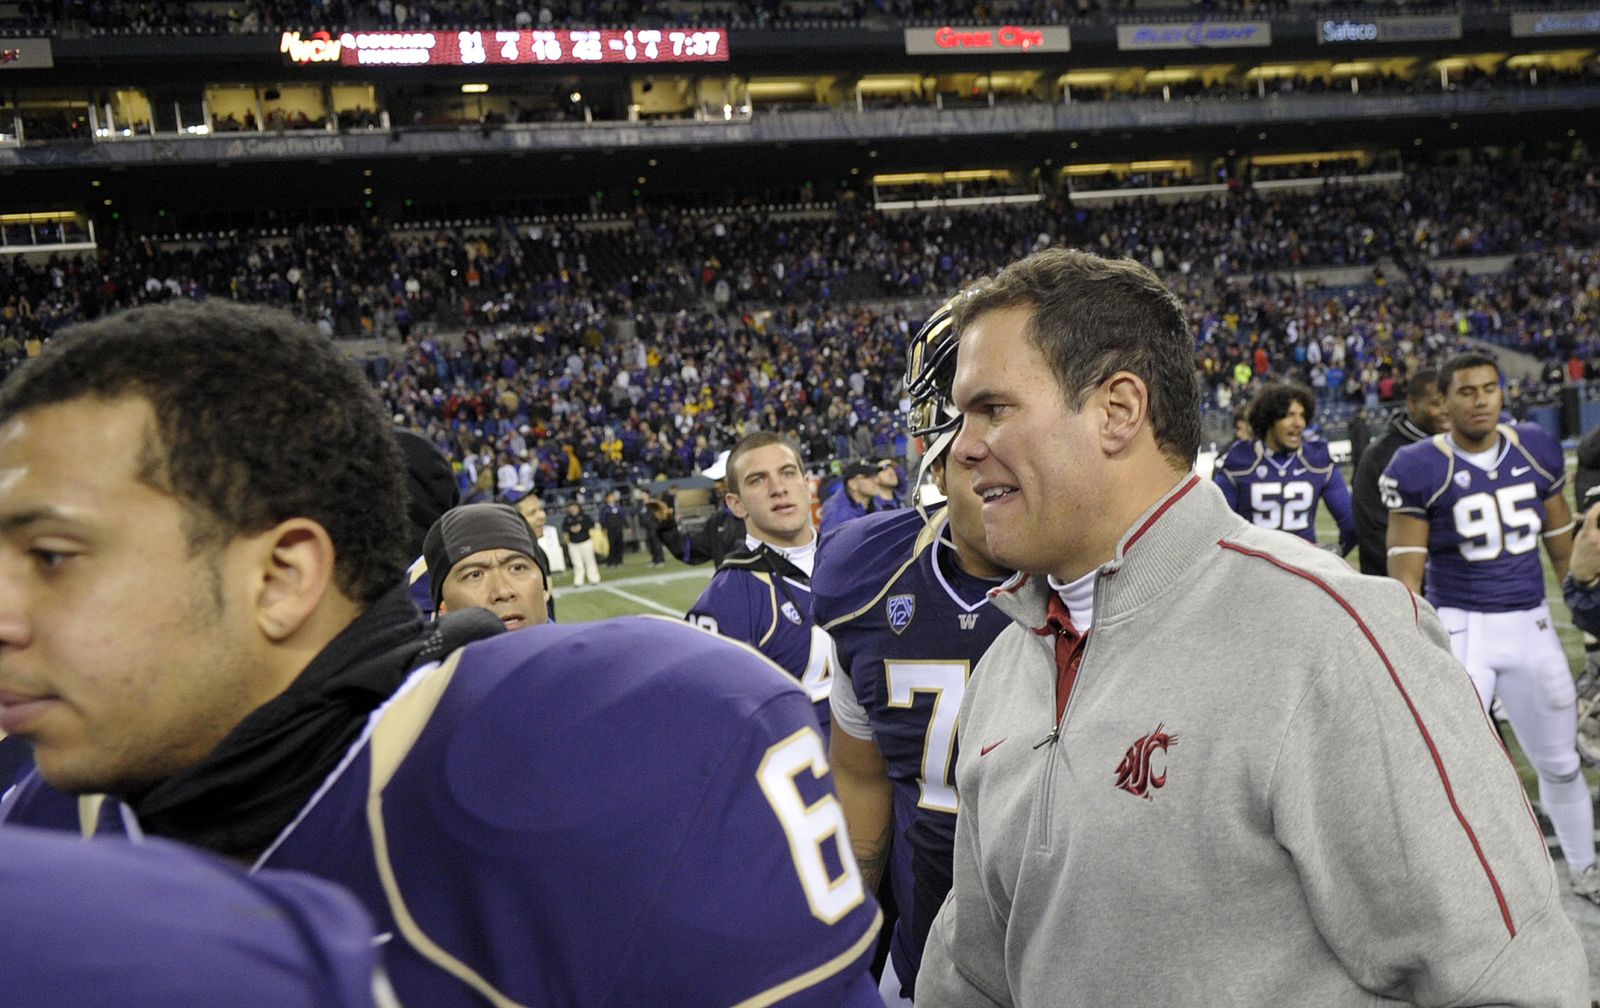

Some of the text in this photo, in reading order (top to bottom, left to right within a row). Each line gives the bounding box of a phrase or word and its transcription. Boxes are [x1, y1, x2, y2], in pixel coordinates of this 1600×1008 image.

[934, 26, 993, 48] Great
[1323, 20, 1377, 41] Safeco
[669, 32, 720, 56] 7:37
[1250, 481, 1314, 531] 52
[1453, 482, 1542, 562] 95
[892, 610, 907, 626] 12
[957, 613, 979, 630] W
[884, 659, 970, 814] 7
[756, 726, 862, 926] 6
